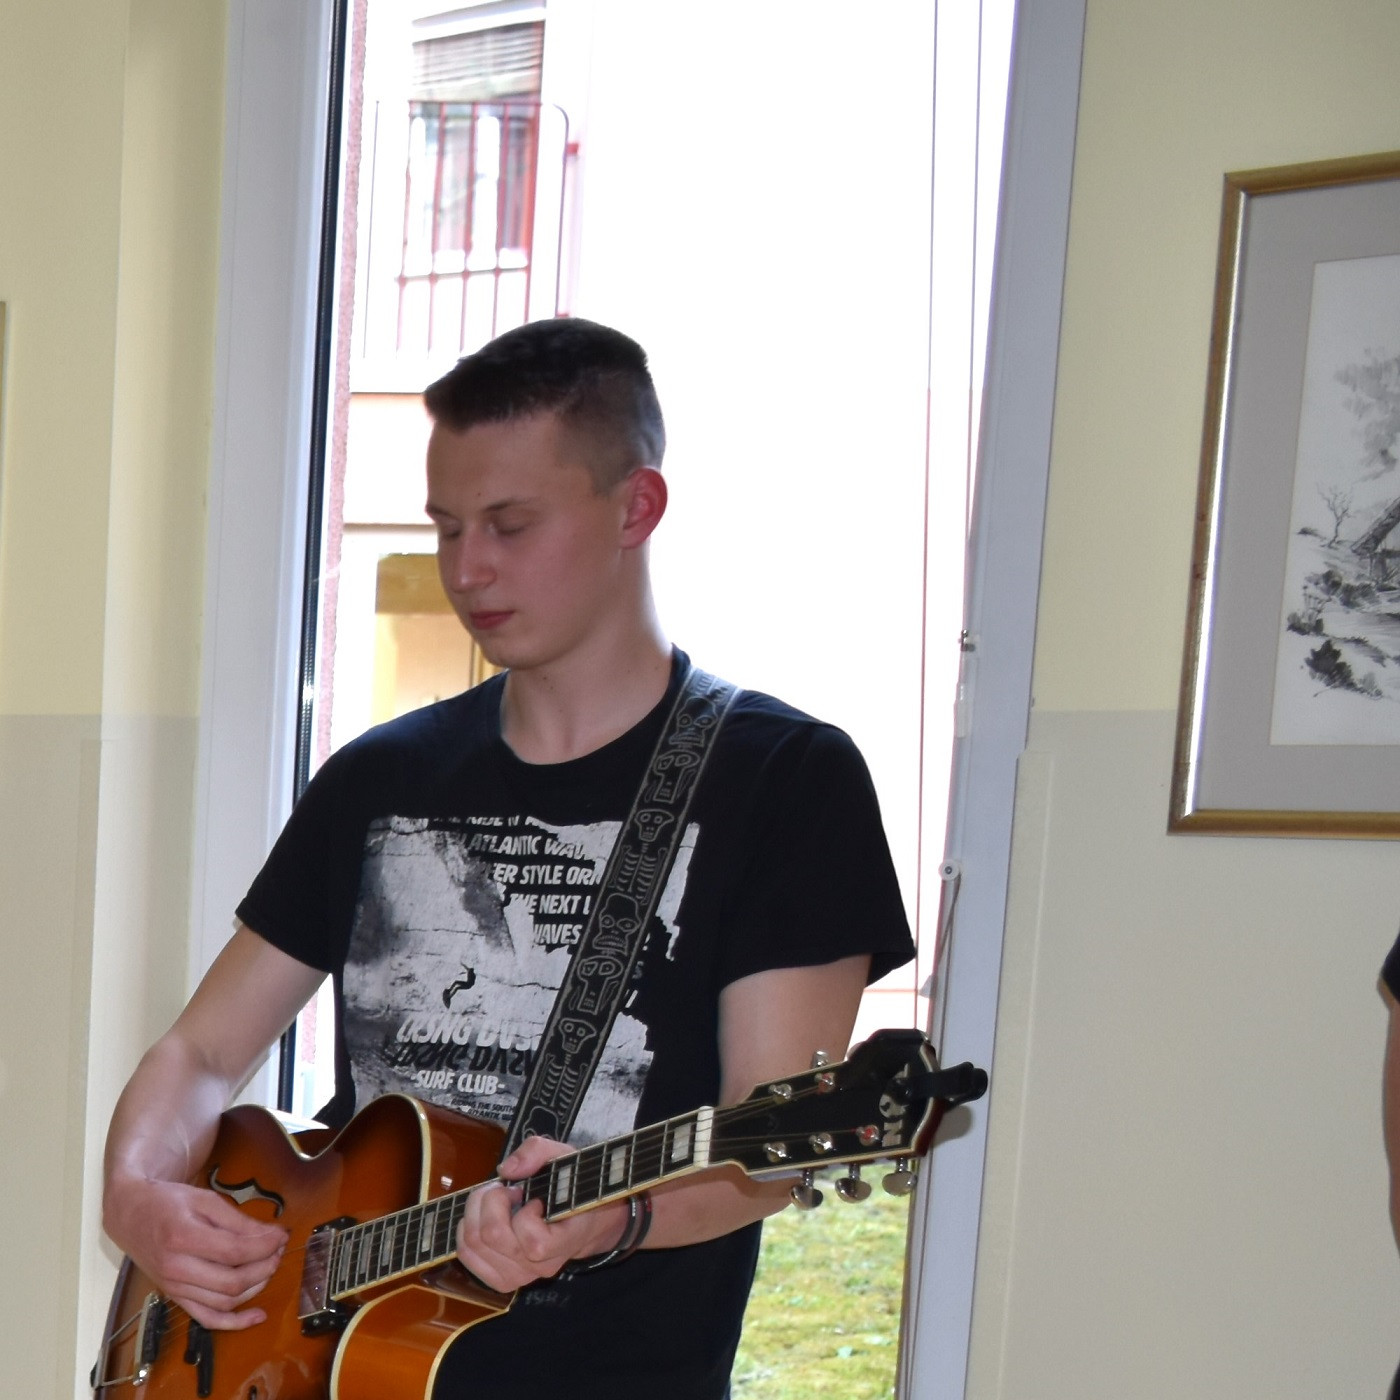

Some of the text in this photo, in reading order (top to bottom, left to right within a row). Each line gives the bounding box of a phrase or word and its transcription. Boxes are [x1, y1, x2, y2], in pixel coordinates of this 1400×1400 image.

[469, 833, 541, 855] ATLANTIC
[519, 863, 565, 885] STYLE
[538, 894, 582, 914] NEXT
